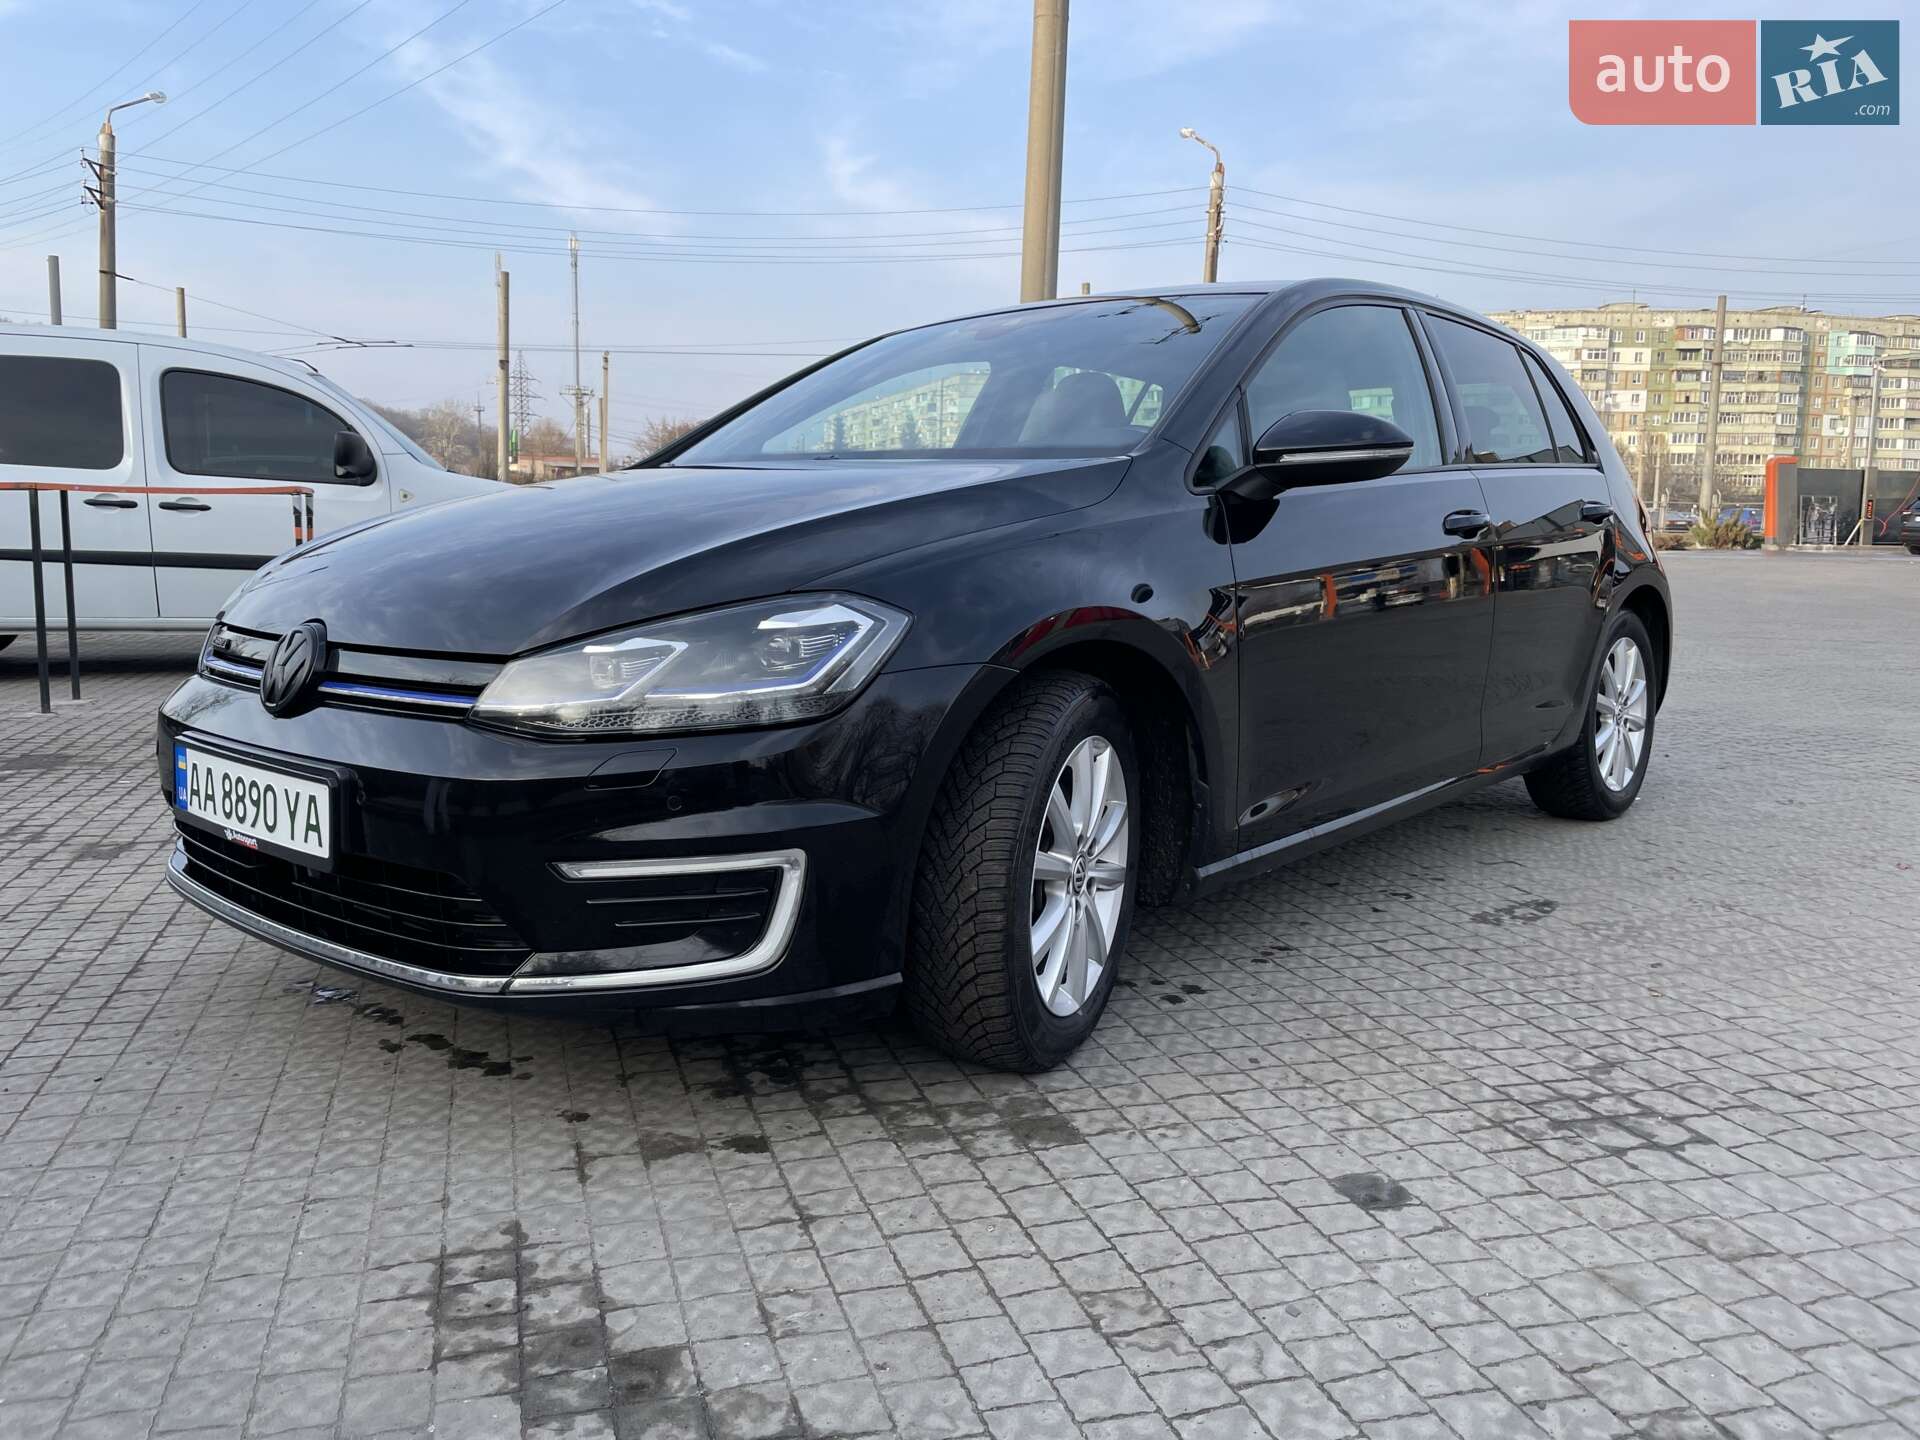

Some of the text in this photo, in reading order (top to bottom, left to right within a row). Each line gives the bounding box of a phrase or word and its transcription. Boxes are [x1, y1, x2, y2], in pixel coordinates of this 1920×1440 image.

[178, 786, 187, 800] UA
[190, 762, 323, 848] AA 8890 YA
